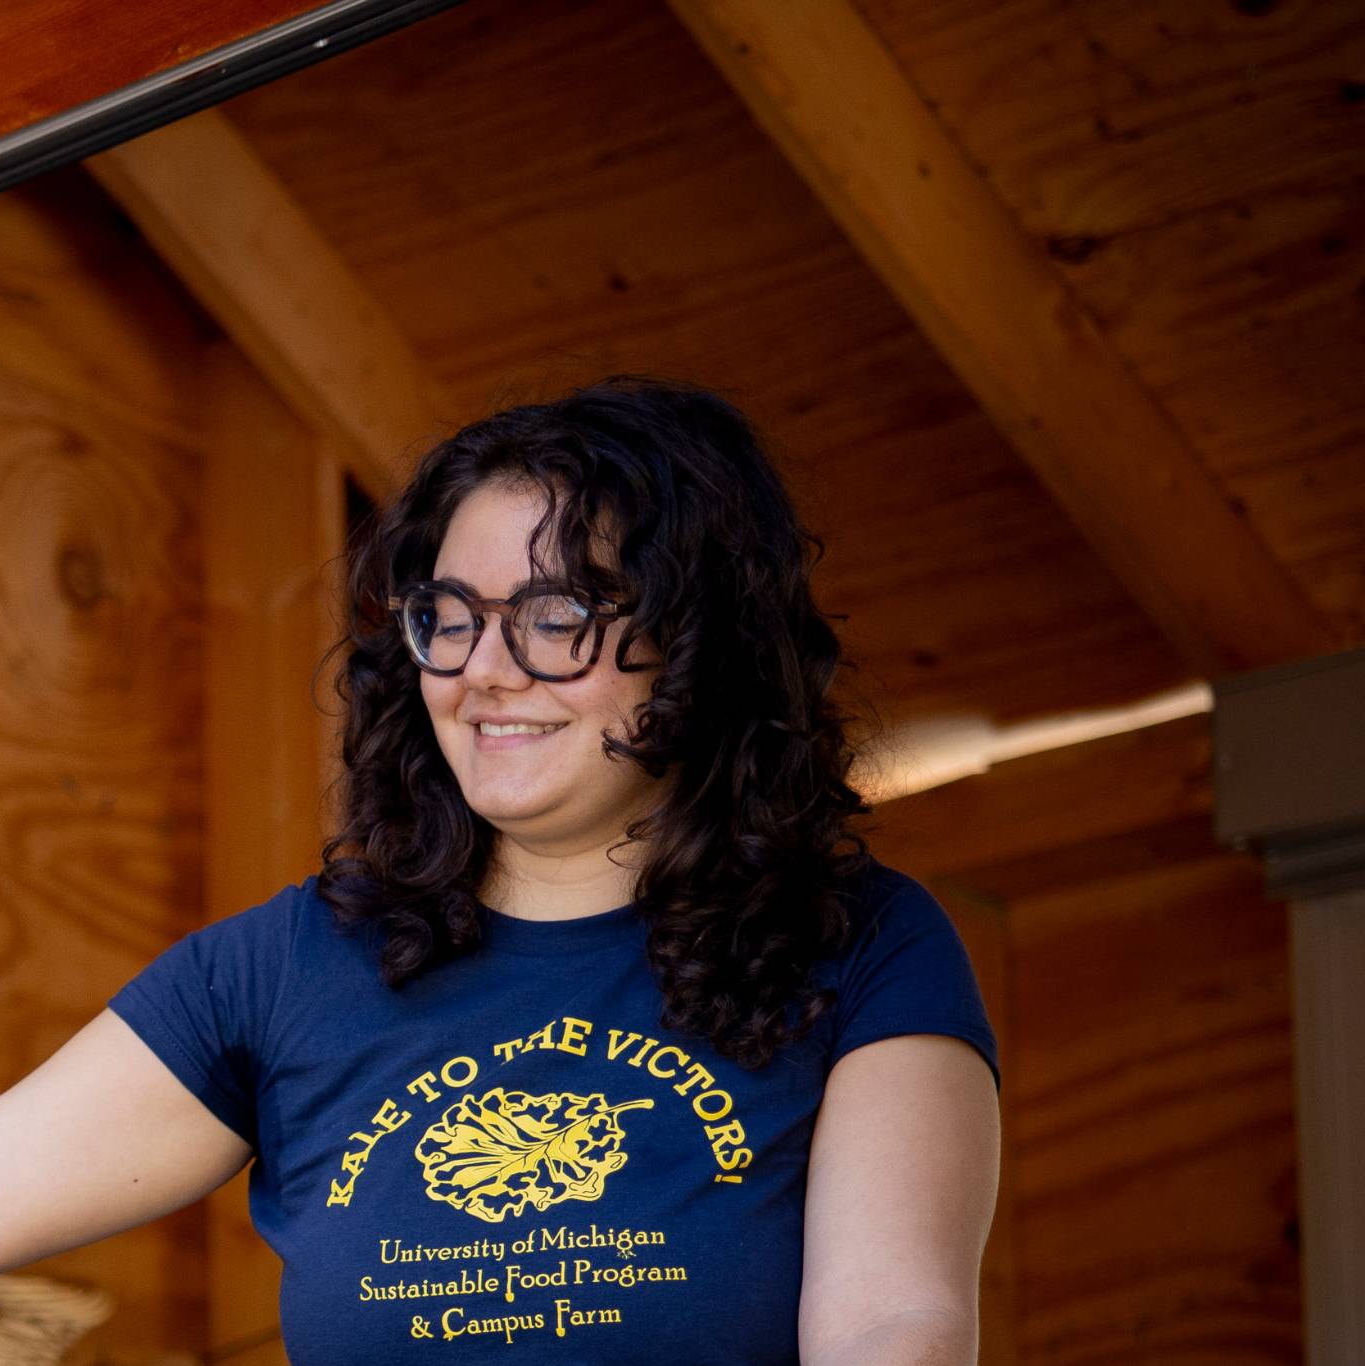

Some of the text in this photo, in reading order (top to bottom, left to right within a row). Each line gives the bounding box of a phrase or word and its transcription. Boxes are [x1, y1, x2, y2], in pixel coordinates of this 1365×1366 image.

[326, 1098, 412, 1207] KALE
[407, 1056, 478, 1103] TO
[606, 1029, 753, 1184] VICTORS!
[379, 1225, 666, 1264] University of Michigan
[359, 1259, 688, 1303] Sustainable Food Program
[410, 1299, 622, 1344] & Campus Farm
